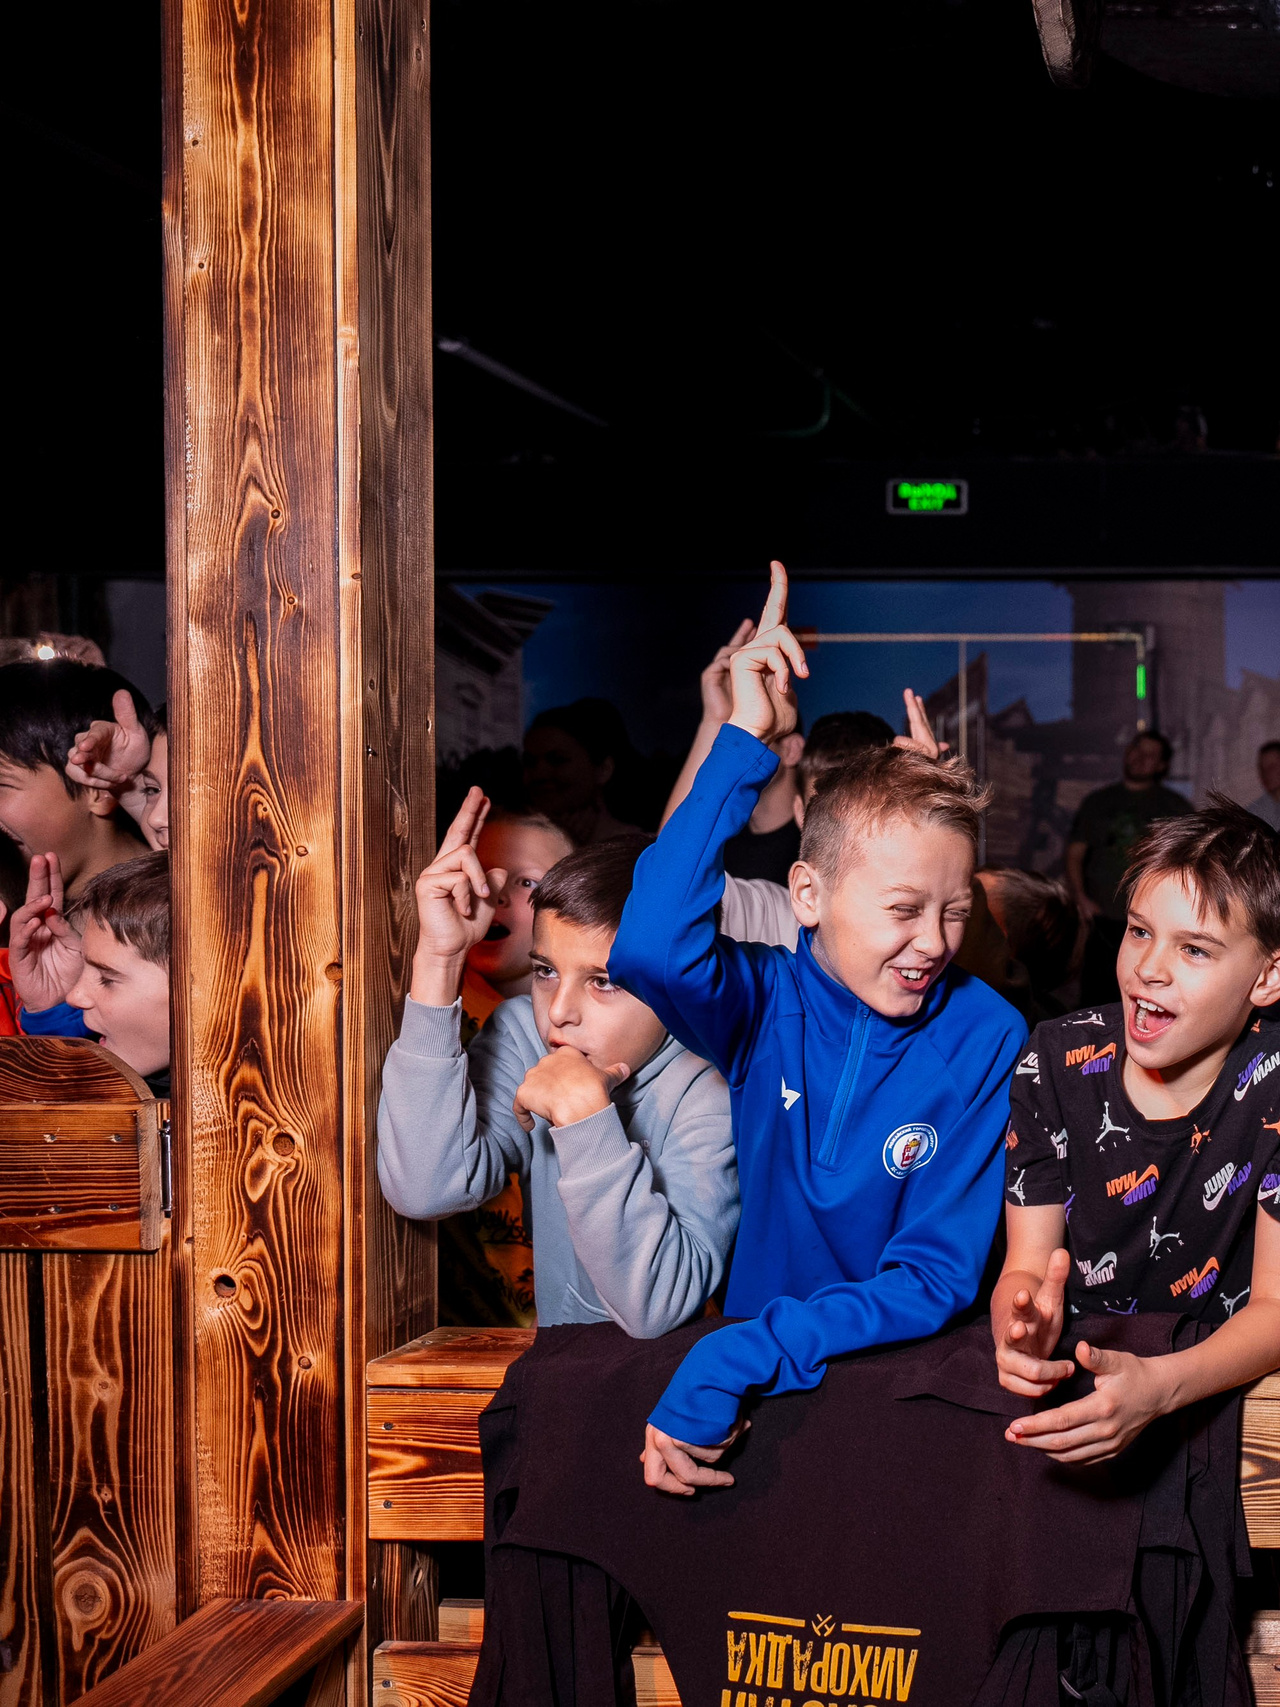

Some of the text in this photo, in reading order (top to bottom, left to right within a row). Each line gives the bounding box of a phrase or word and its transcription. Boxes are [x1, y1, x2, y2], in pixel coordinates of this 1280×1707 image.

[1253, 1051, 1280, 1086] MAN
[1099, 1134, 1132, 1152] AIR
[1106, 1169, 1138, 1197] MAN
[1203, 1161, 1236, 1199] JUMP
[1169, 1266, 1200, 1298] MAN
[726, 1630, 919, 1702] ЛИХОРАДКА
